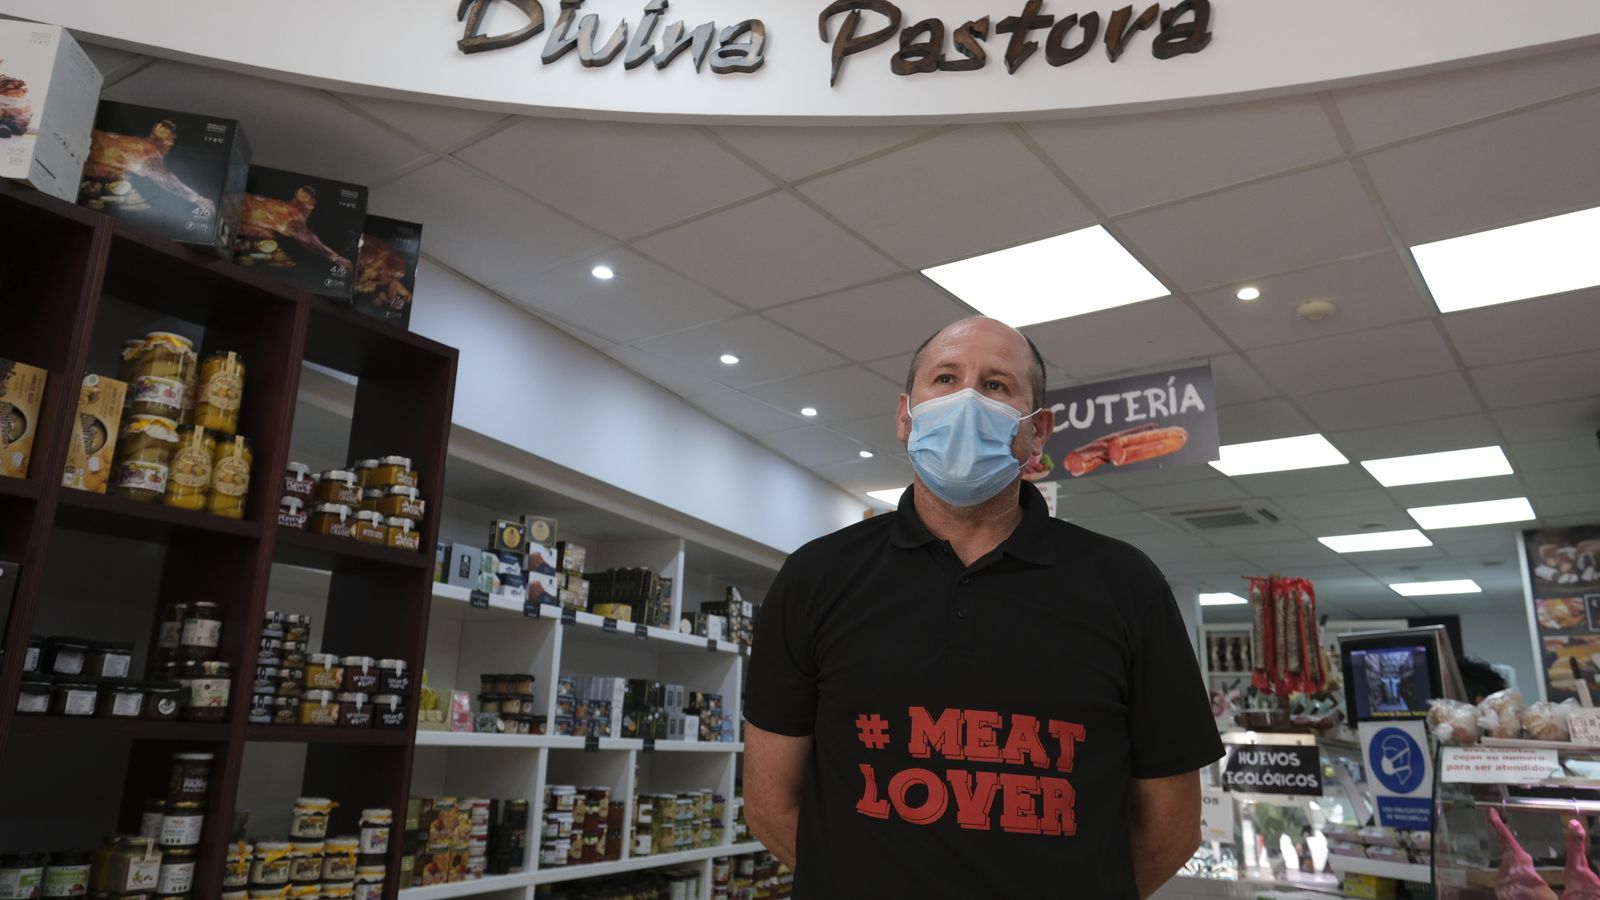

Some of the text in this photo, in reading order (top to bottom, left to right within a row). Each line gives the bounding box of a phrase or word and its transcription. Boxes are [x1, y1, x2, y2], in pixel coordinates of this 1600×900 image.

[457, 0, 1212, 88] Divina Pastora
[908, 706, 1087, 773] MEAT
[1238, 751, 1301, 766] HUEVOS
[856, 763, 1078, 837] LOVER
[1226, 769, 1319, 788] ECOLÓGICOS
